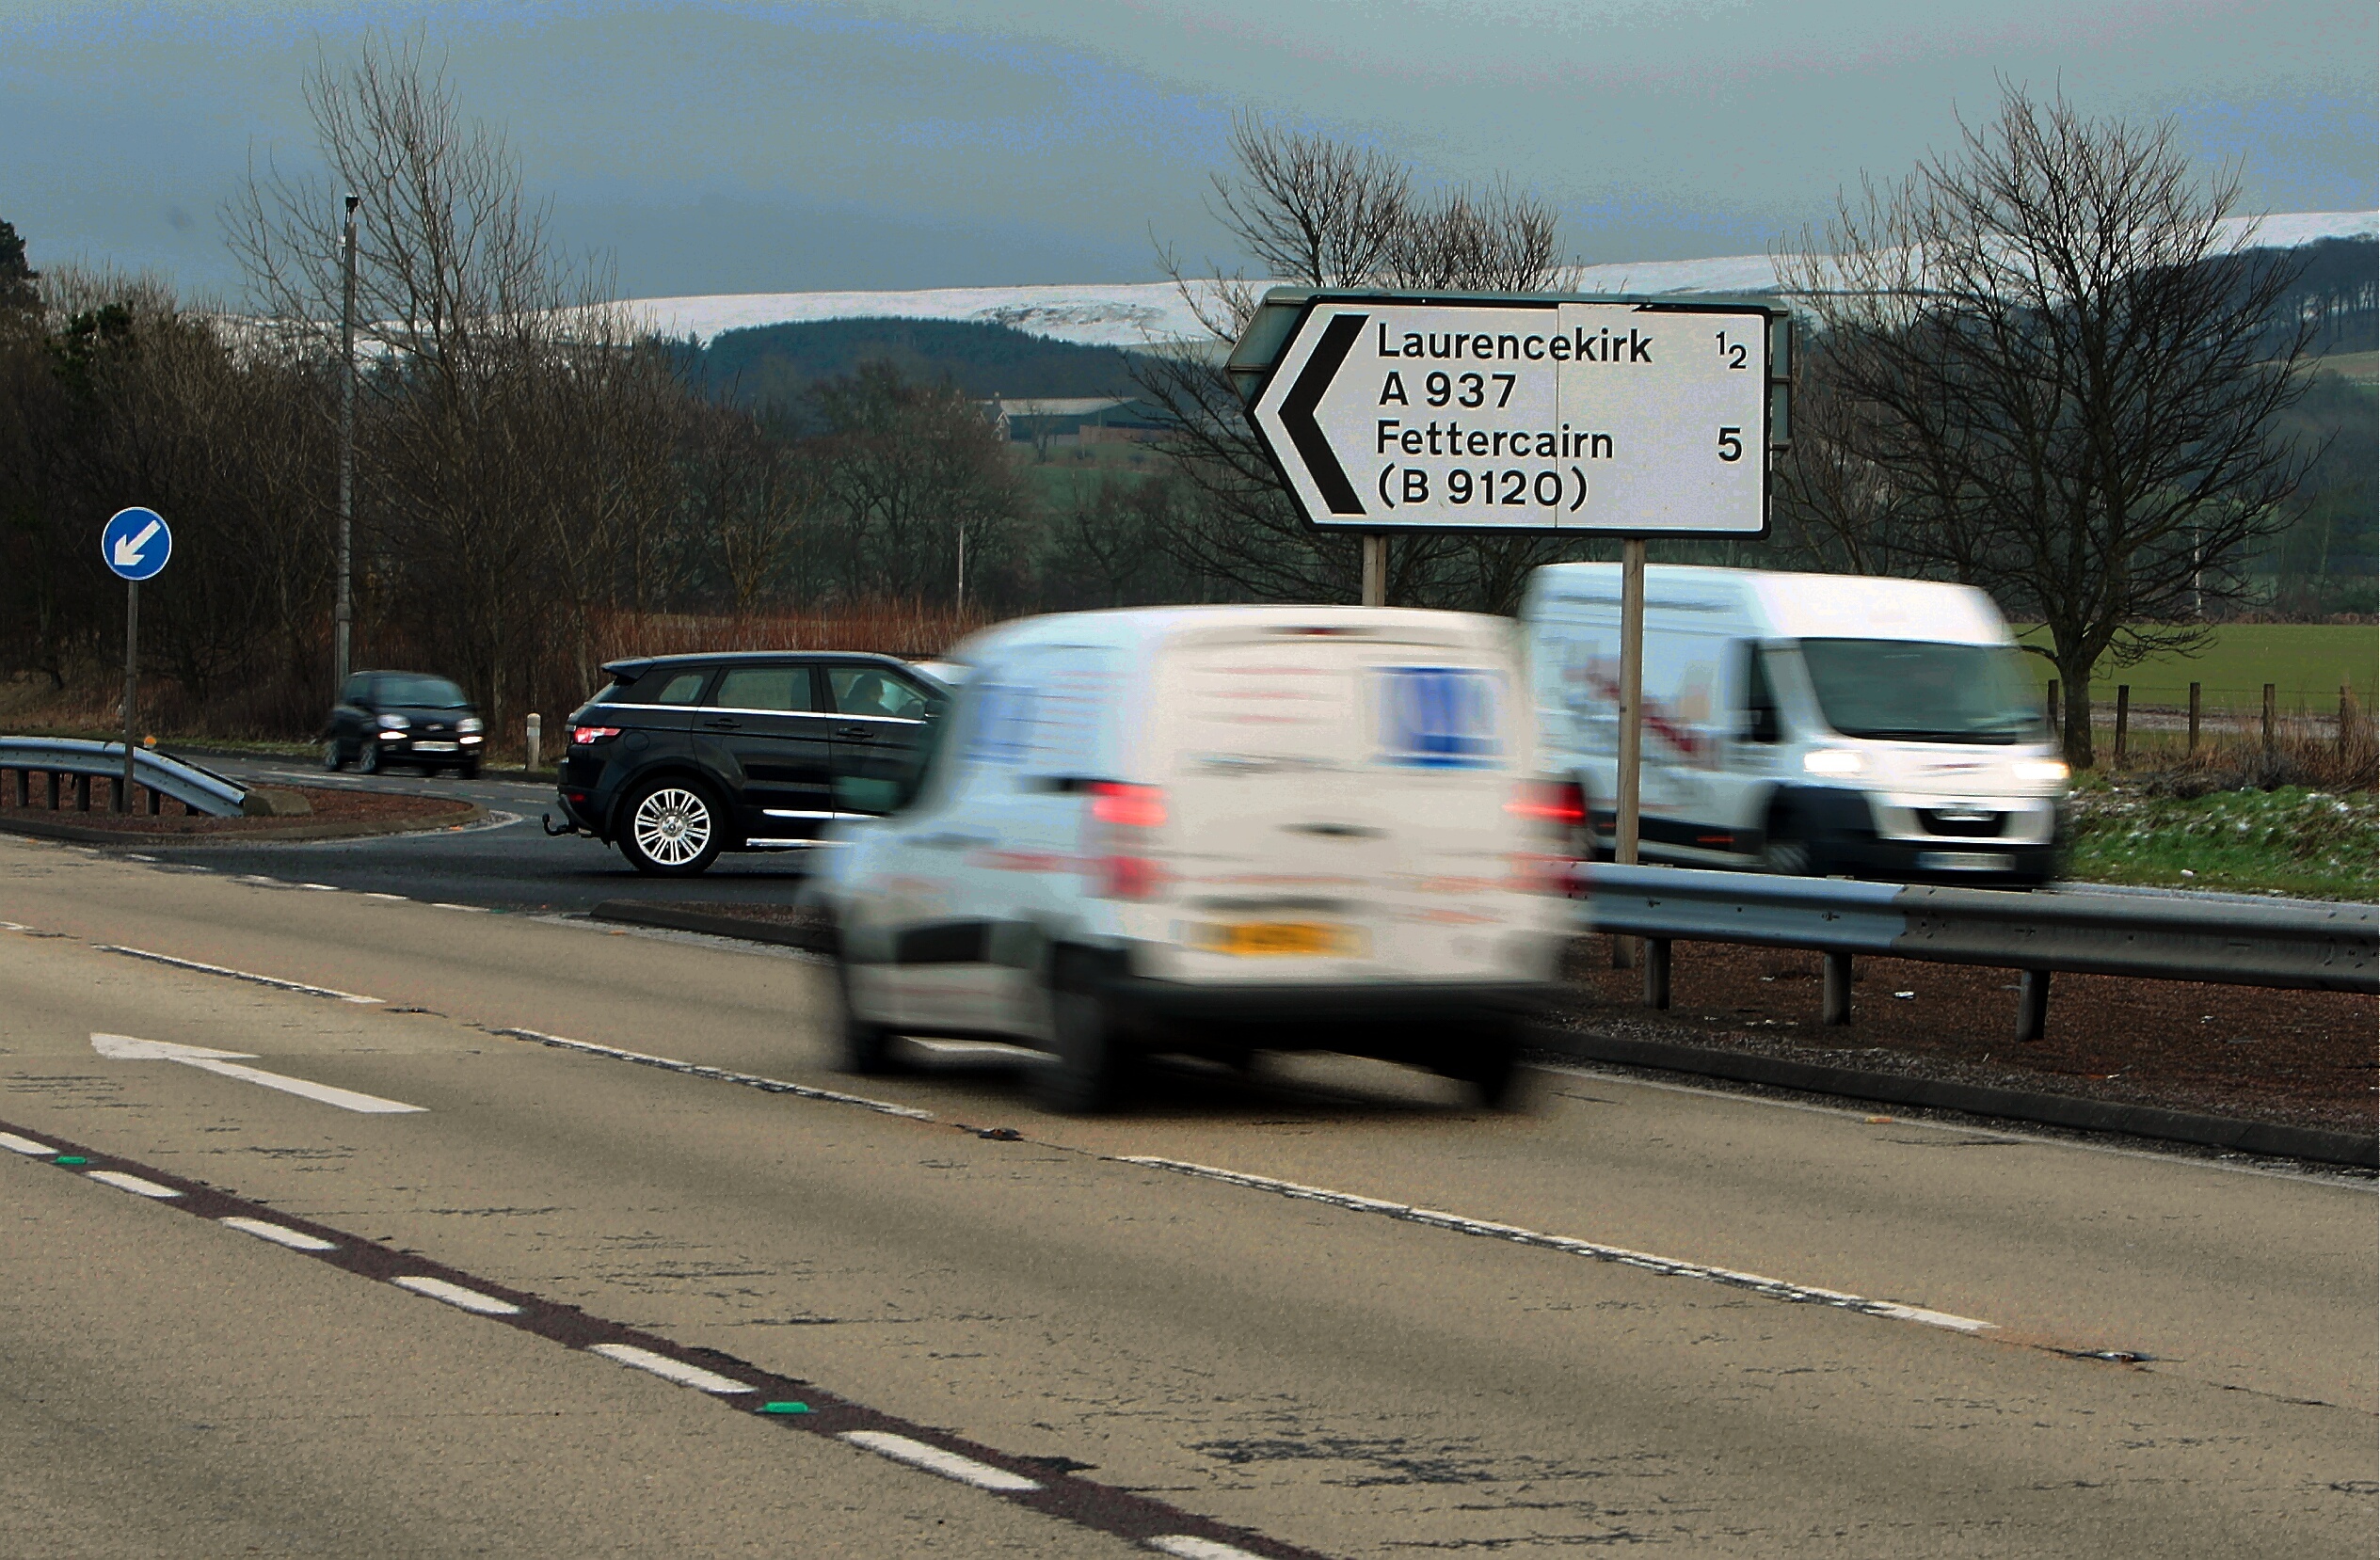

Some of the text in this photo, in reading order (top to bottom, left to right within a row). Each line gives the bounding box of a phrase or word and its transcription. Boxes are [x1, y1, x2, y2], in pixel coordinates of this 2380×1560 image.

[1379, 322, 1653, 363] Laurencekirk
[1379, 371, 1516, 408] A 937
[1377, 420, 1744, 462] Fettercairn 5
[1379, 463, 1588, 513] (B 9120)
